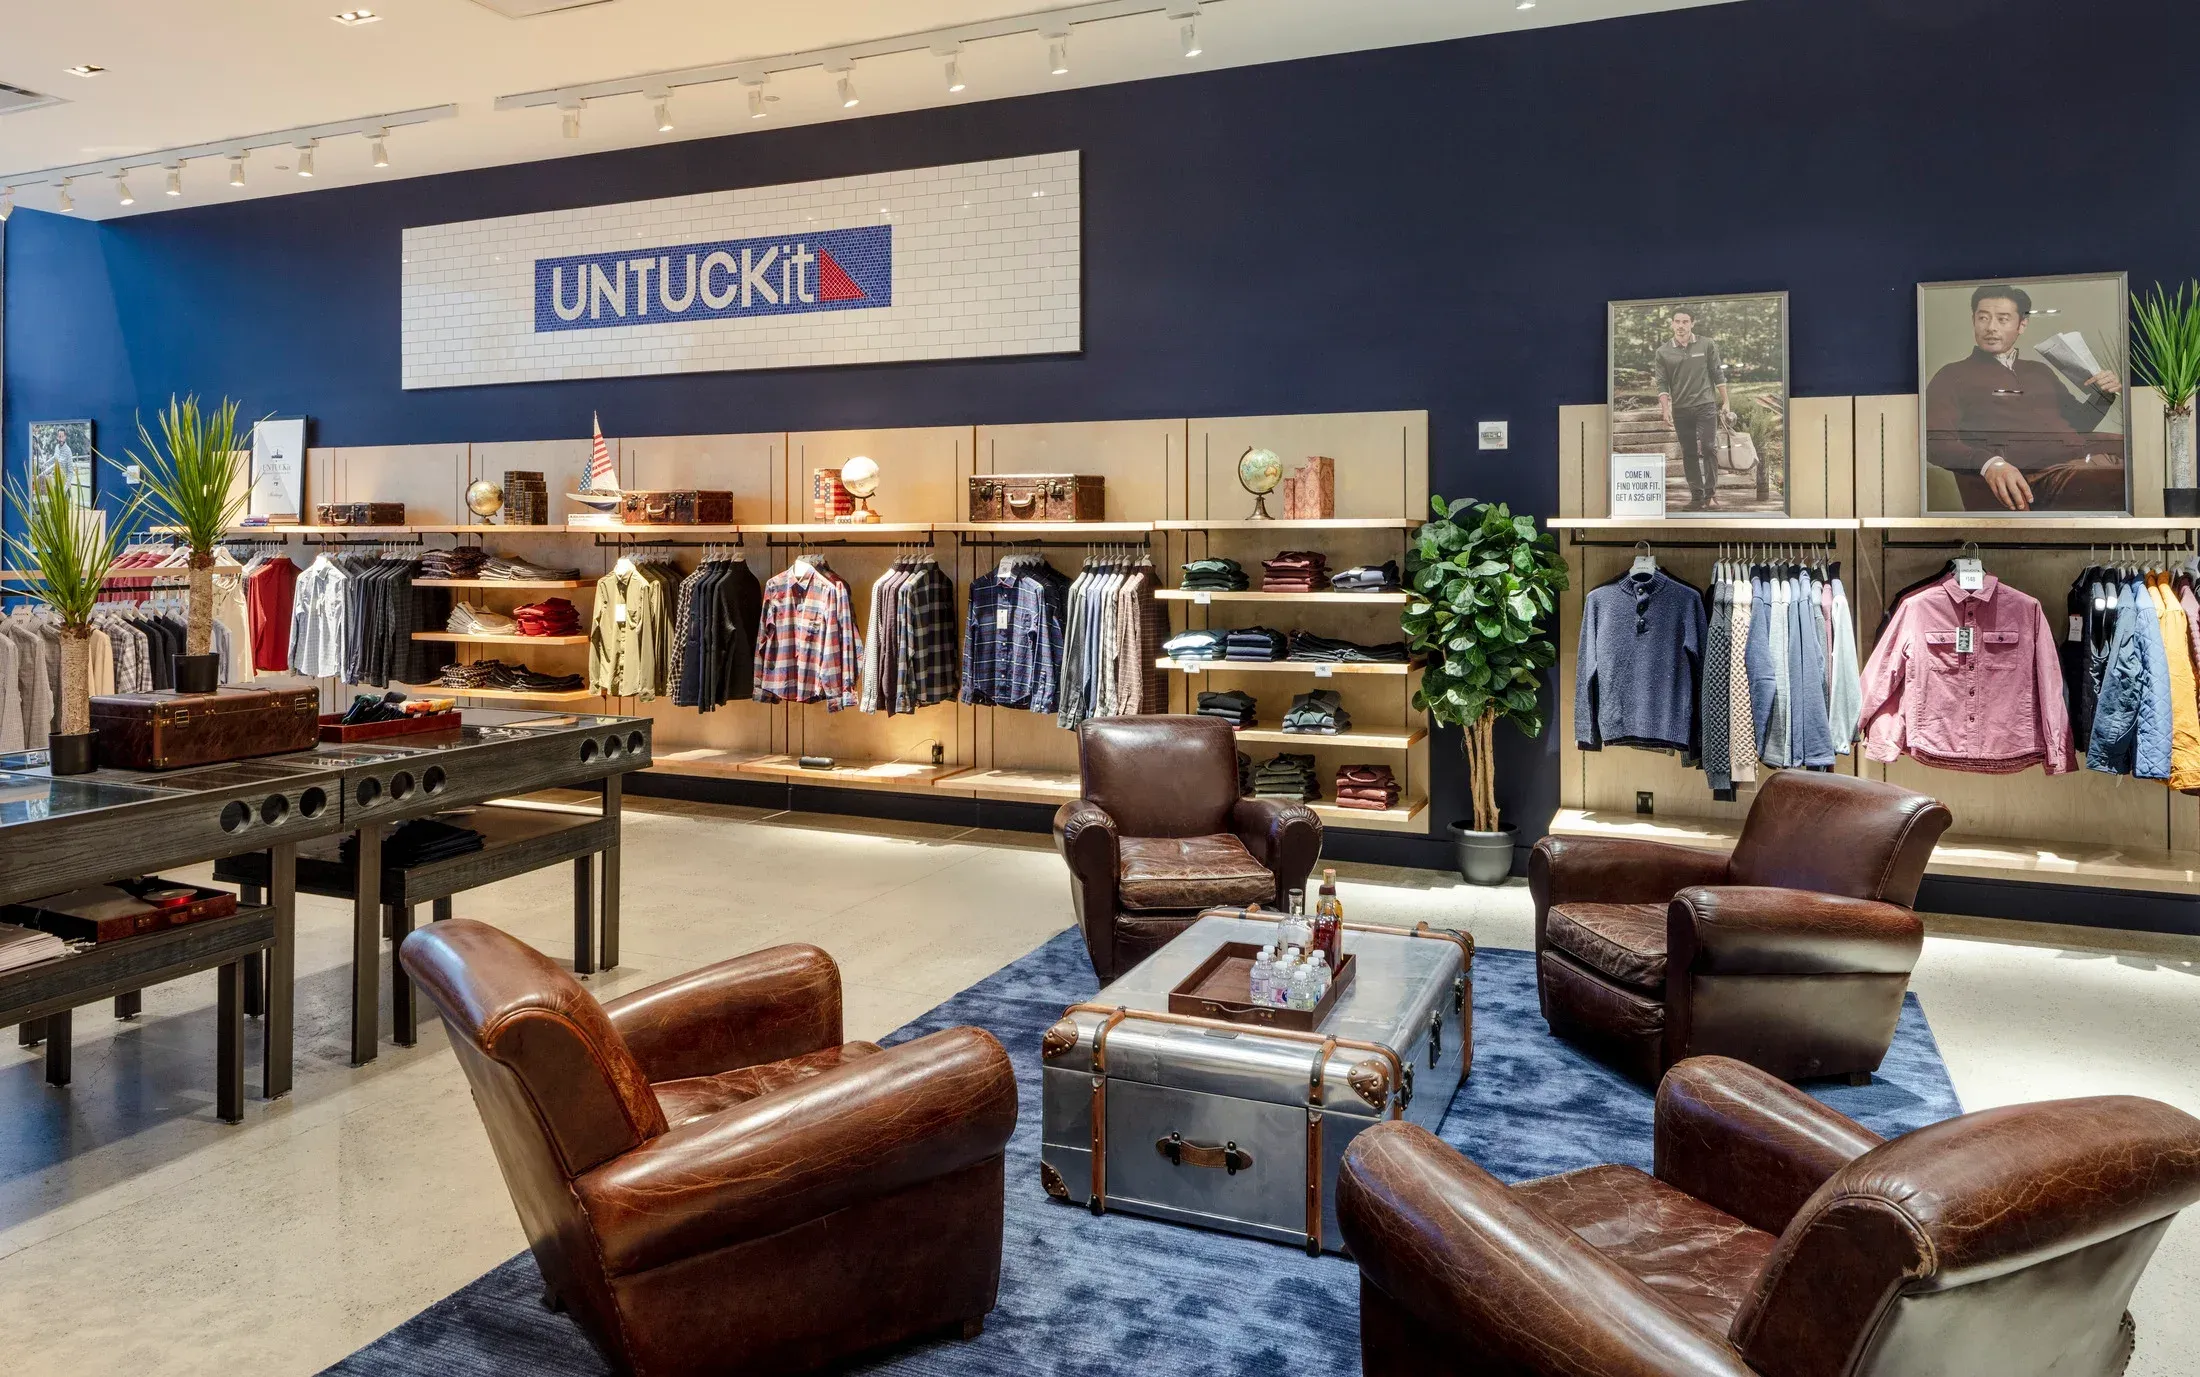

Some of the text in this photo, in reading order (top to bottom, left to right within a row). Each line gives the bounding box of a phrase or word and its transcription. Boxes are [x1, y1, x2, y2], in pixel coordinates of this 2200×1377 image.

[553, 243, 814, 321] UNTUCKit
[1617, 482, 1660, 490] FIND YOUR FIT.
